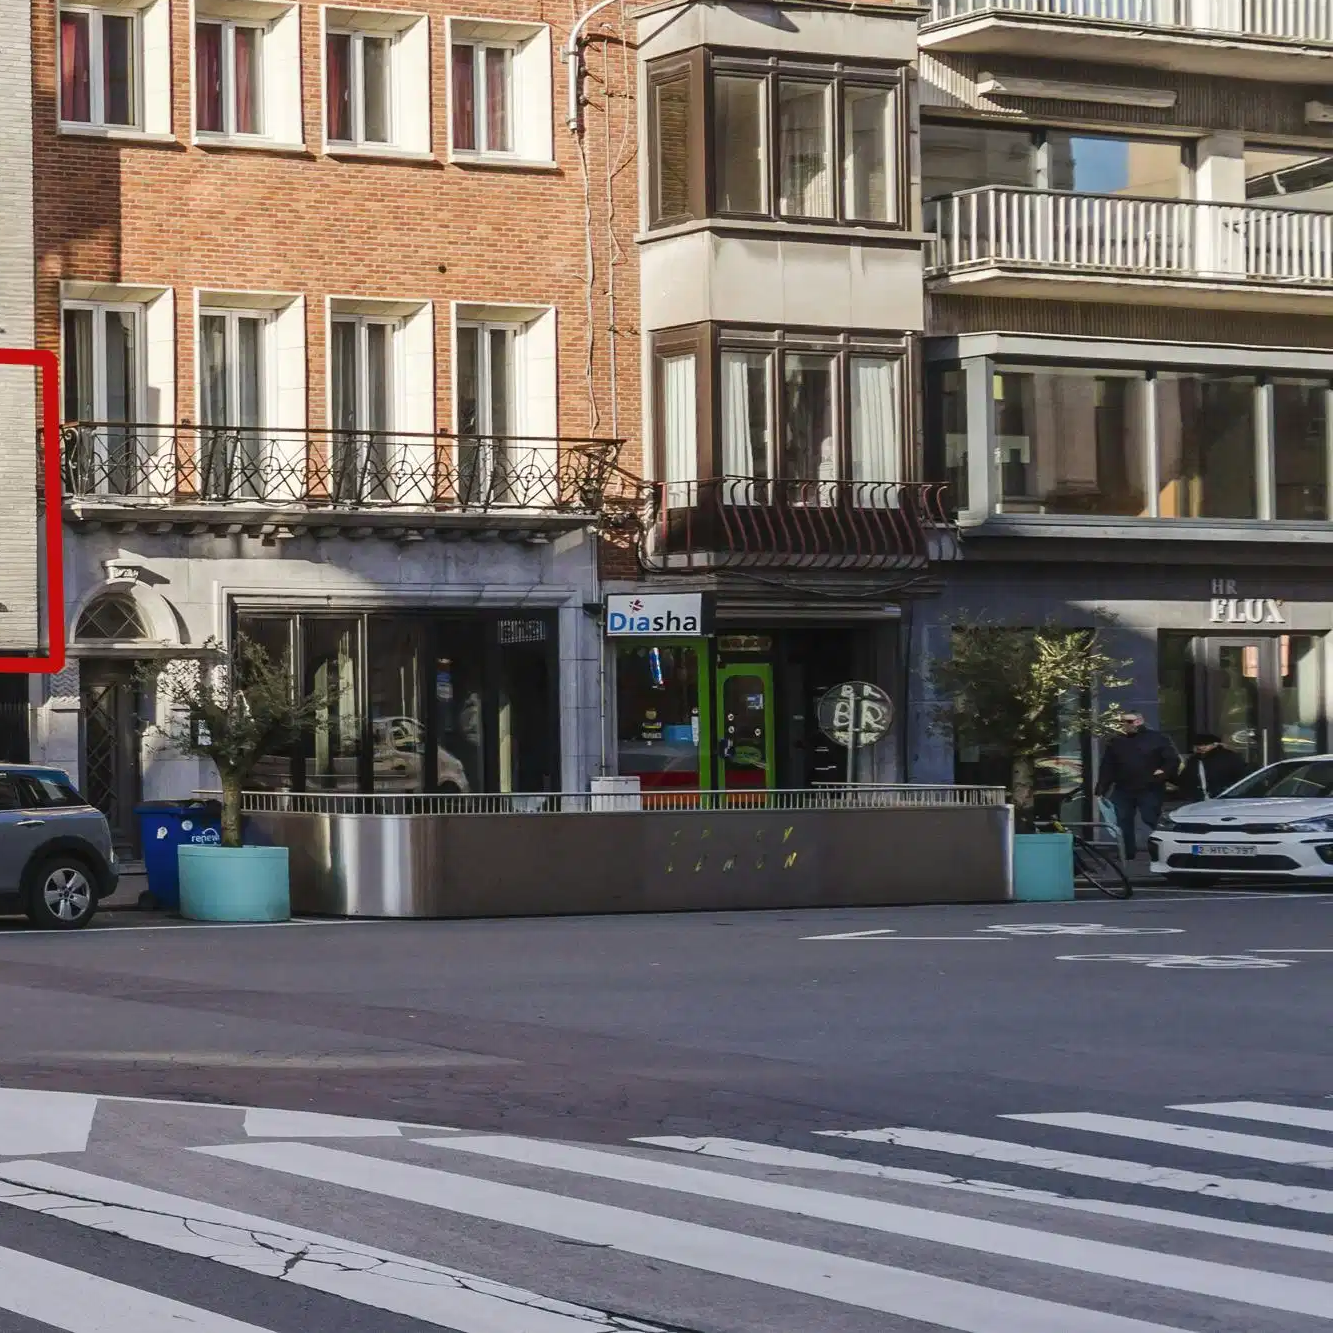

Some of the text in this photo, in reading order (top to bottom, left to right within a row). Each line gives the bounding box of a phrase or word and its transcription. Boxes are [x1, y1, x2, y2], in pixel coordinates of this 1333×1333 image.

[1213, 578, 1237, 594] HR
[610, 610, 697, 632] Diasha
[1209, 597, 1286, 623] FLUX
